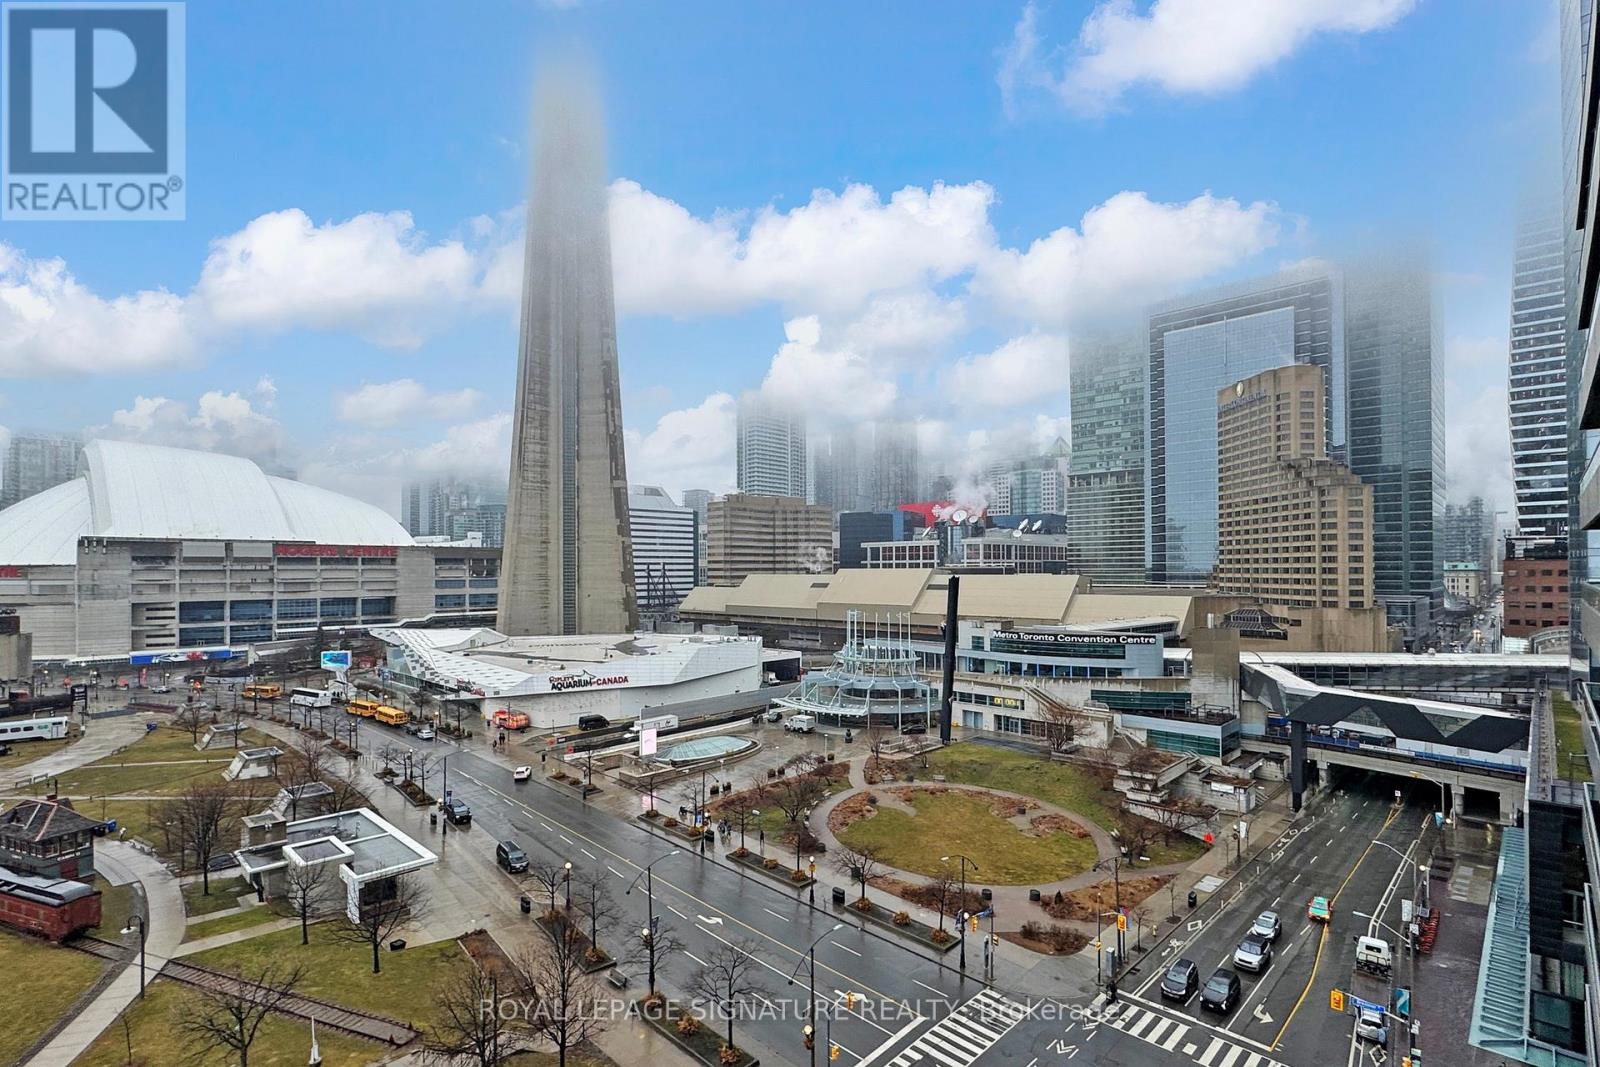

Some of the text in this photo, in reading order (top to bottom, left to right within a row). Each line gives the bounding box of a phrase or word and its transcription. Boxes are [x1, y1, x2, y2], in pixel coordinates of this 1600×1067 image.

[993, 631, 1156, 644] Metro Toronto Convention Centre
[551, 678, 592, 690] AQUARIUM
[597, 676, 628, 685] CANADA
